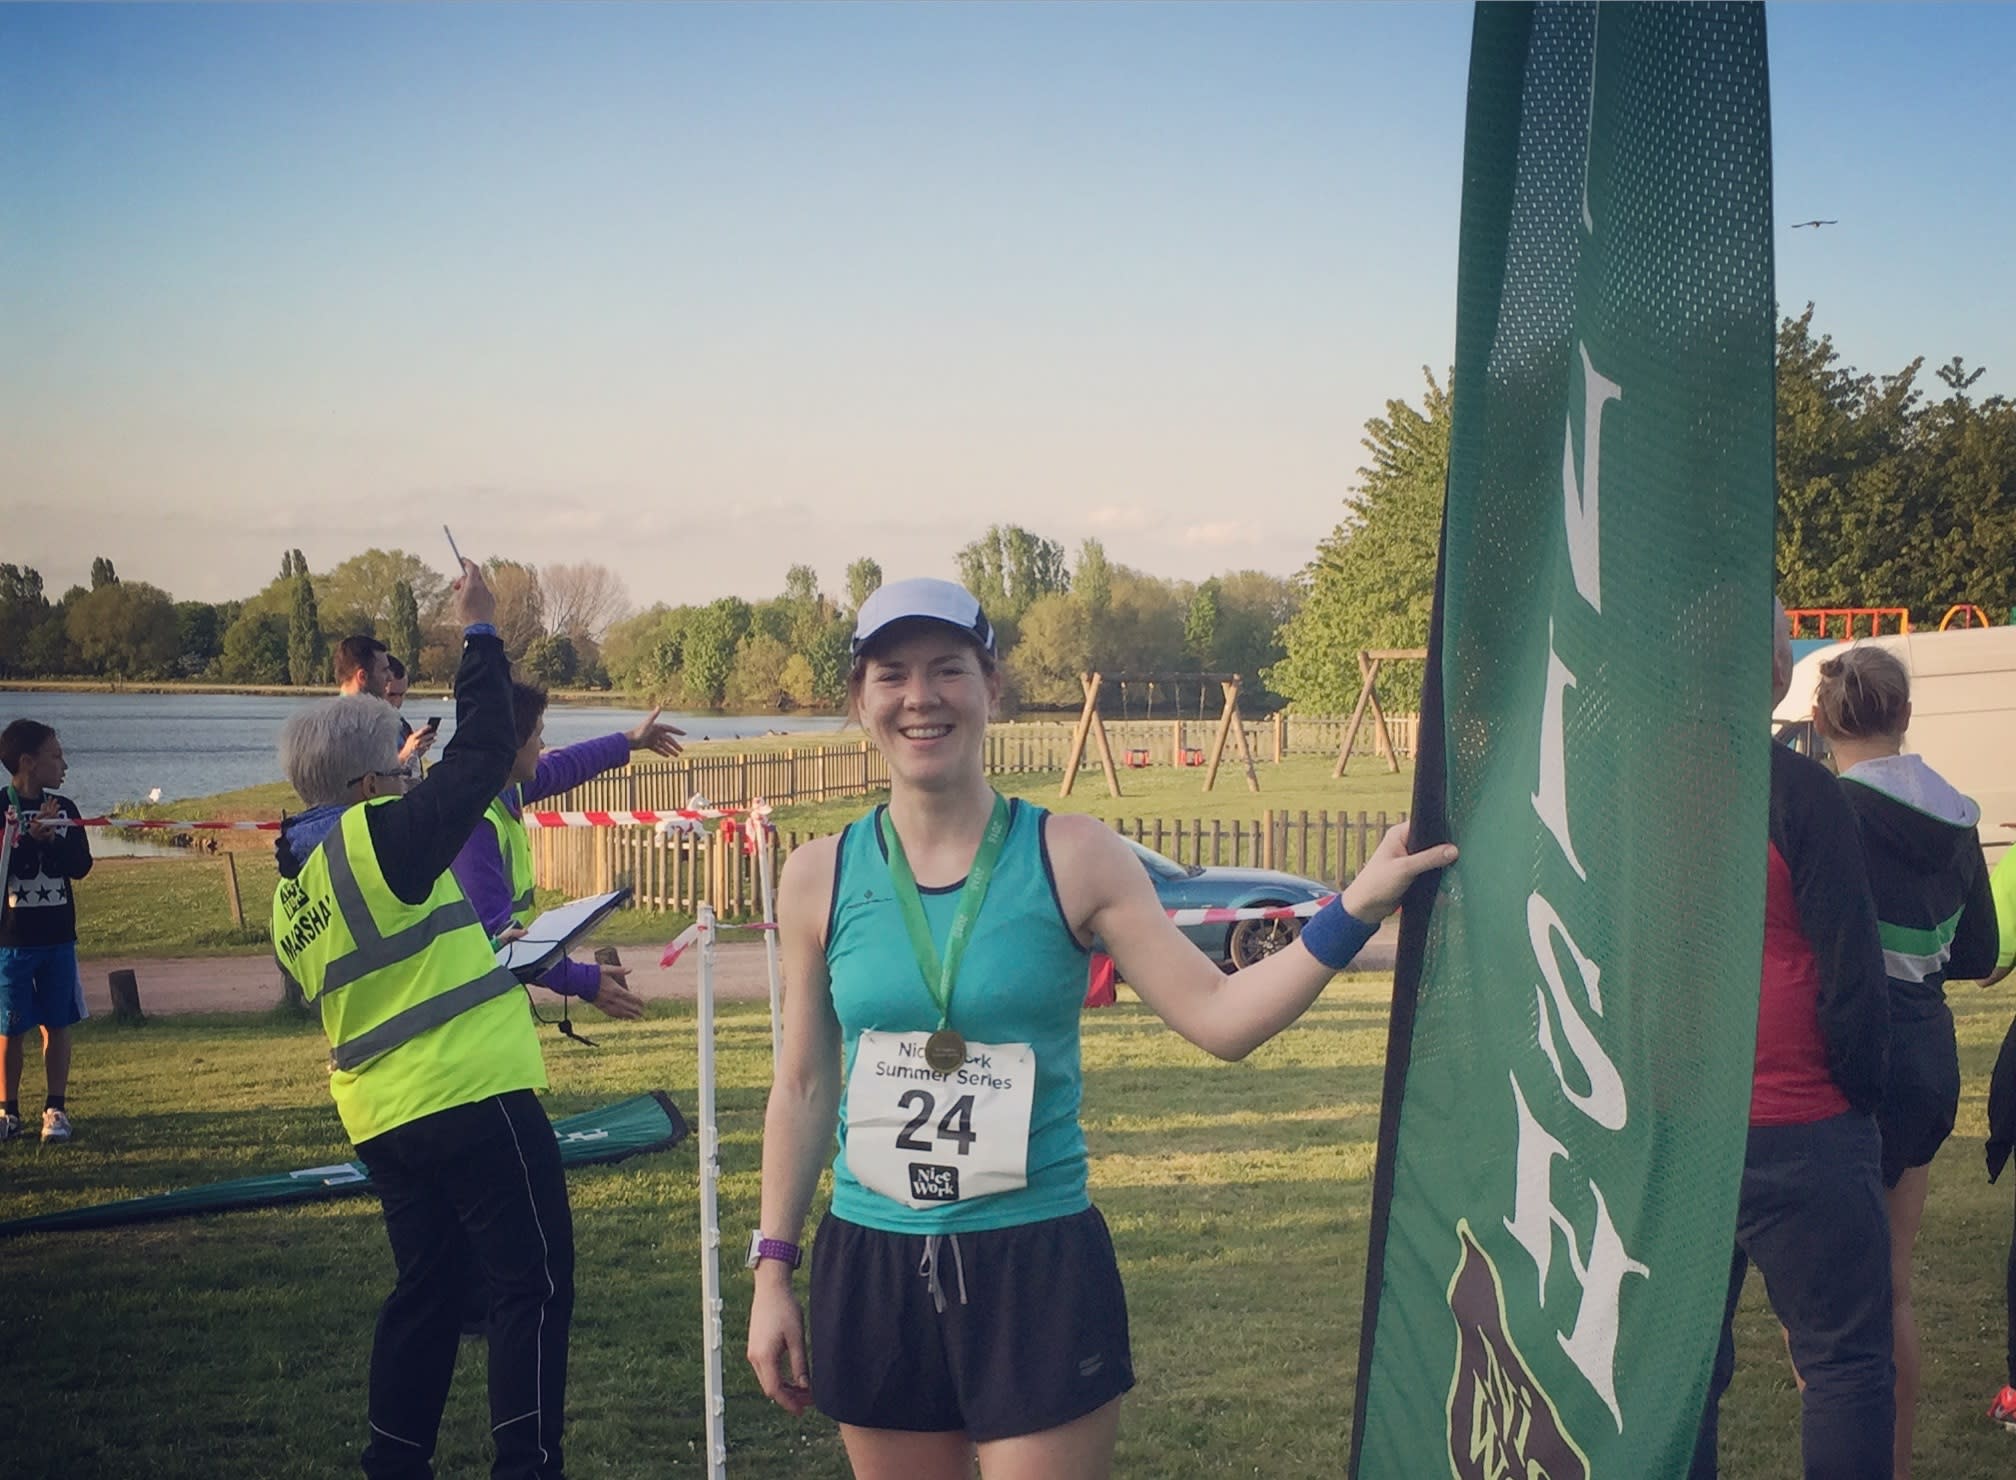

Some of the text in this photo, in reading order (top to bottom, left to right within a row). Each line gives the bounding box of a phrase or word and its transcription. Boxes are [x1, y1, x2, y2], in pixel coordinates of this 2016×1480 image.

[899, 1042, 926, 1059] Nic
[876, 1061, 1012, 1090] Summer Series
[895, 1089, 977, 1156] 24
[917, 1167, 952, 1184] Nice
[912, 1181, 955, 1197] Work
